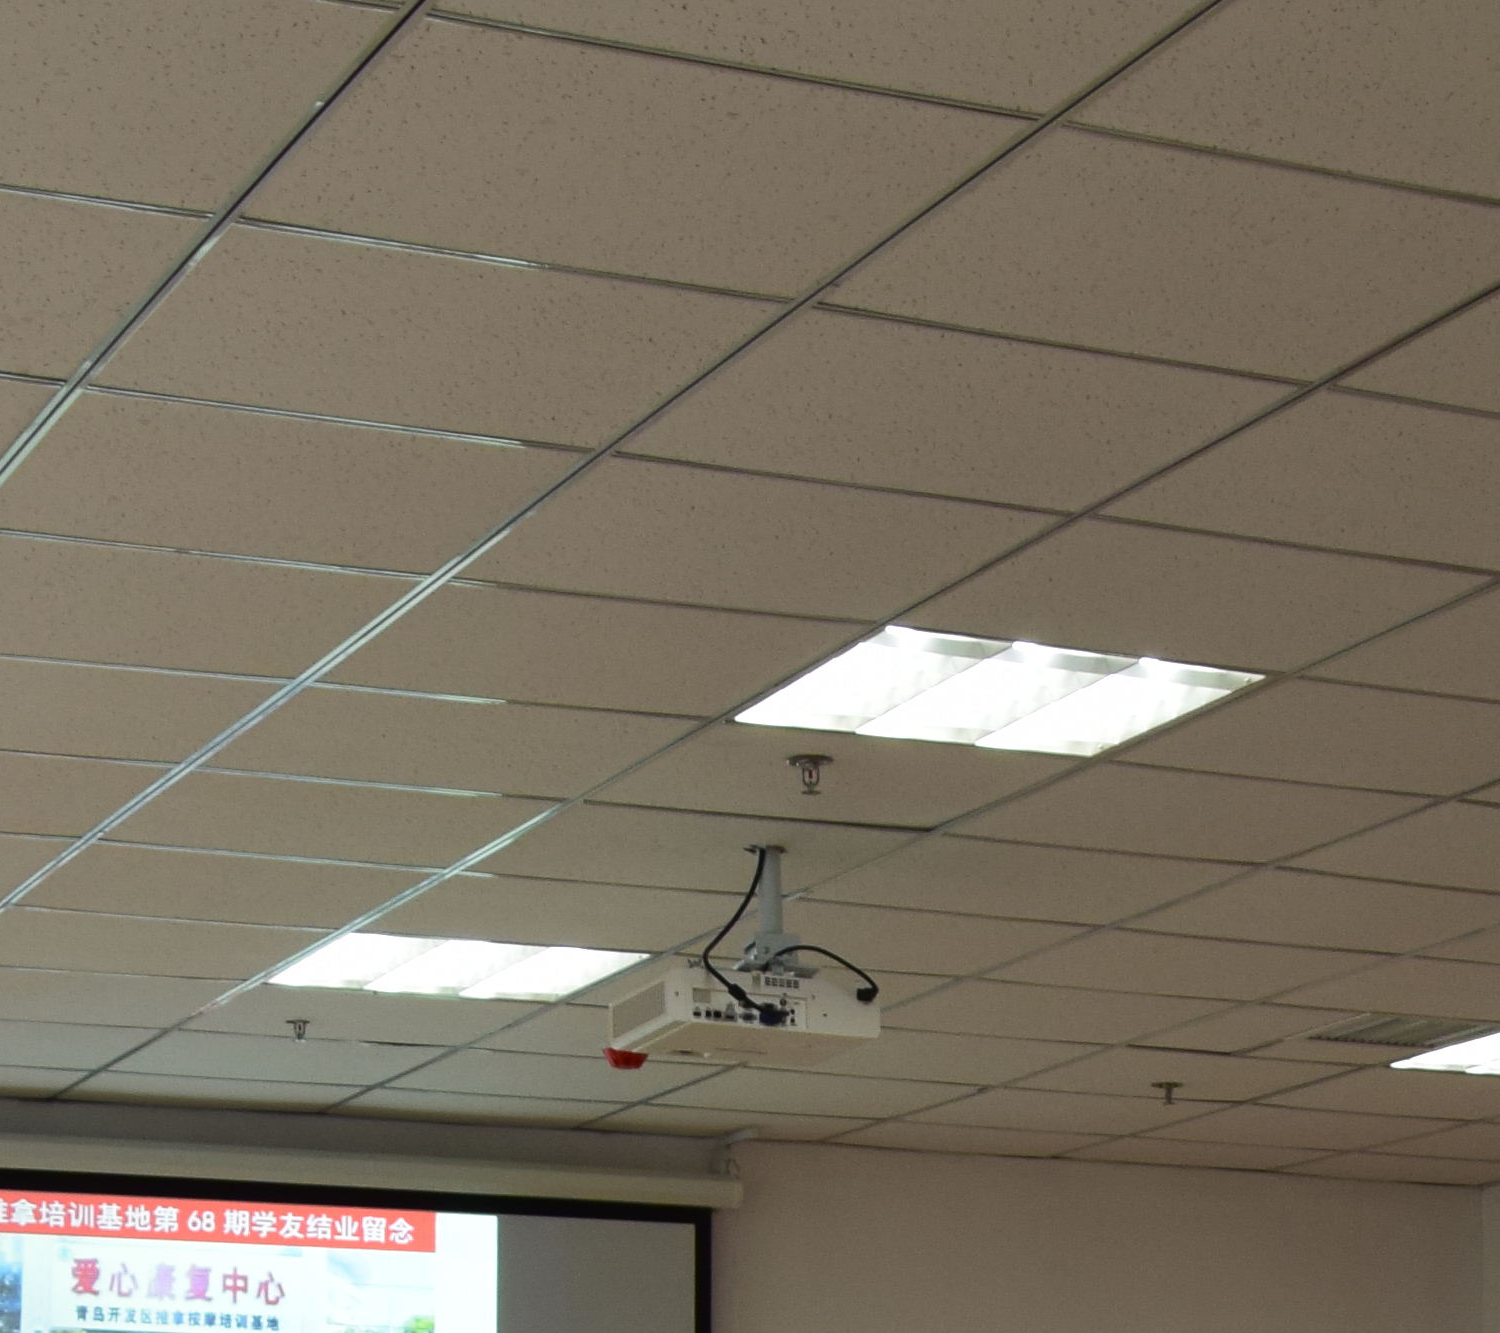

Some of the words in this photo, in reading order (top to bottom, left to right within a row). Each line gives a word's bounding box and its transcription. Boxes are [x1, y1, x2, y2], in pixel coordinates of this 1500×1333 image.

[71, 1257, 286, 1307] 爱心康复中心
